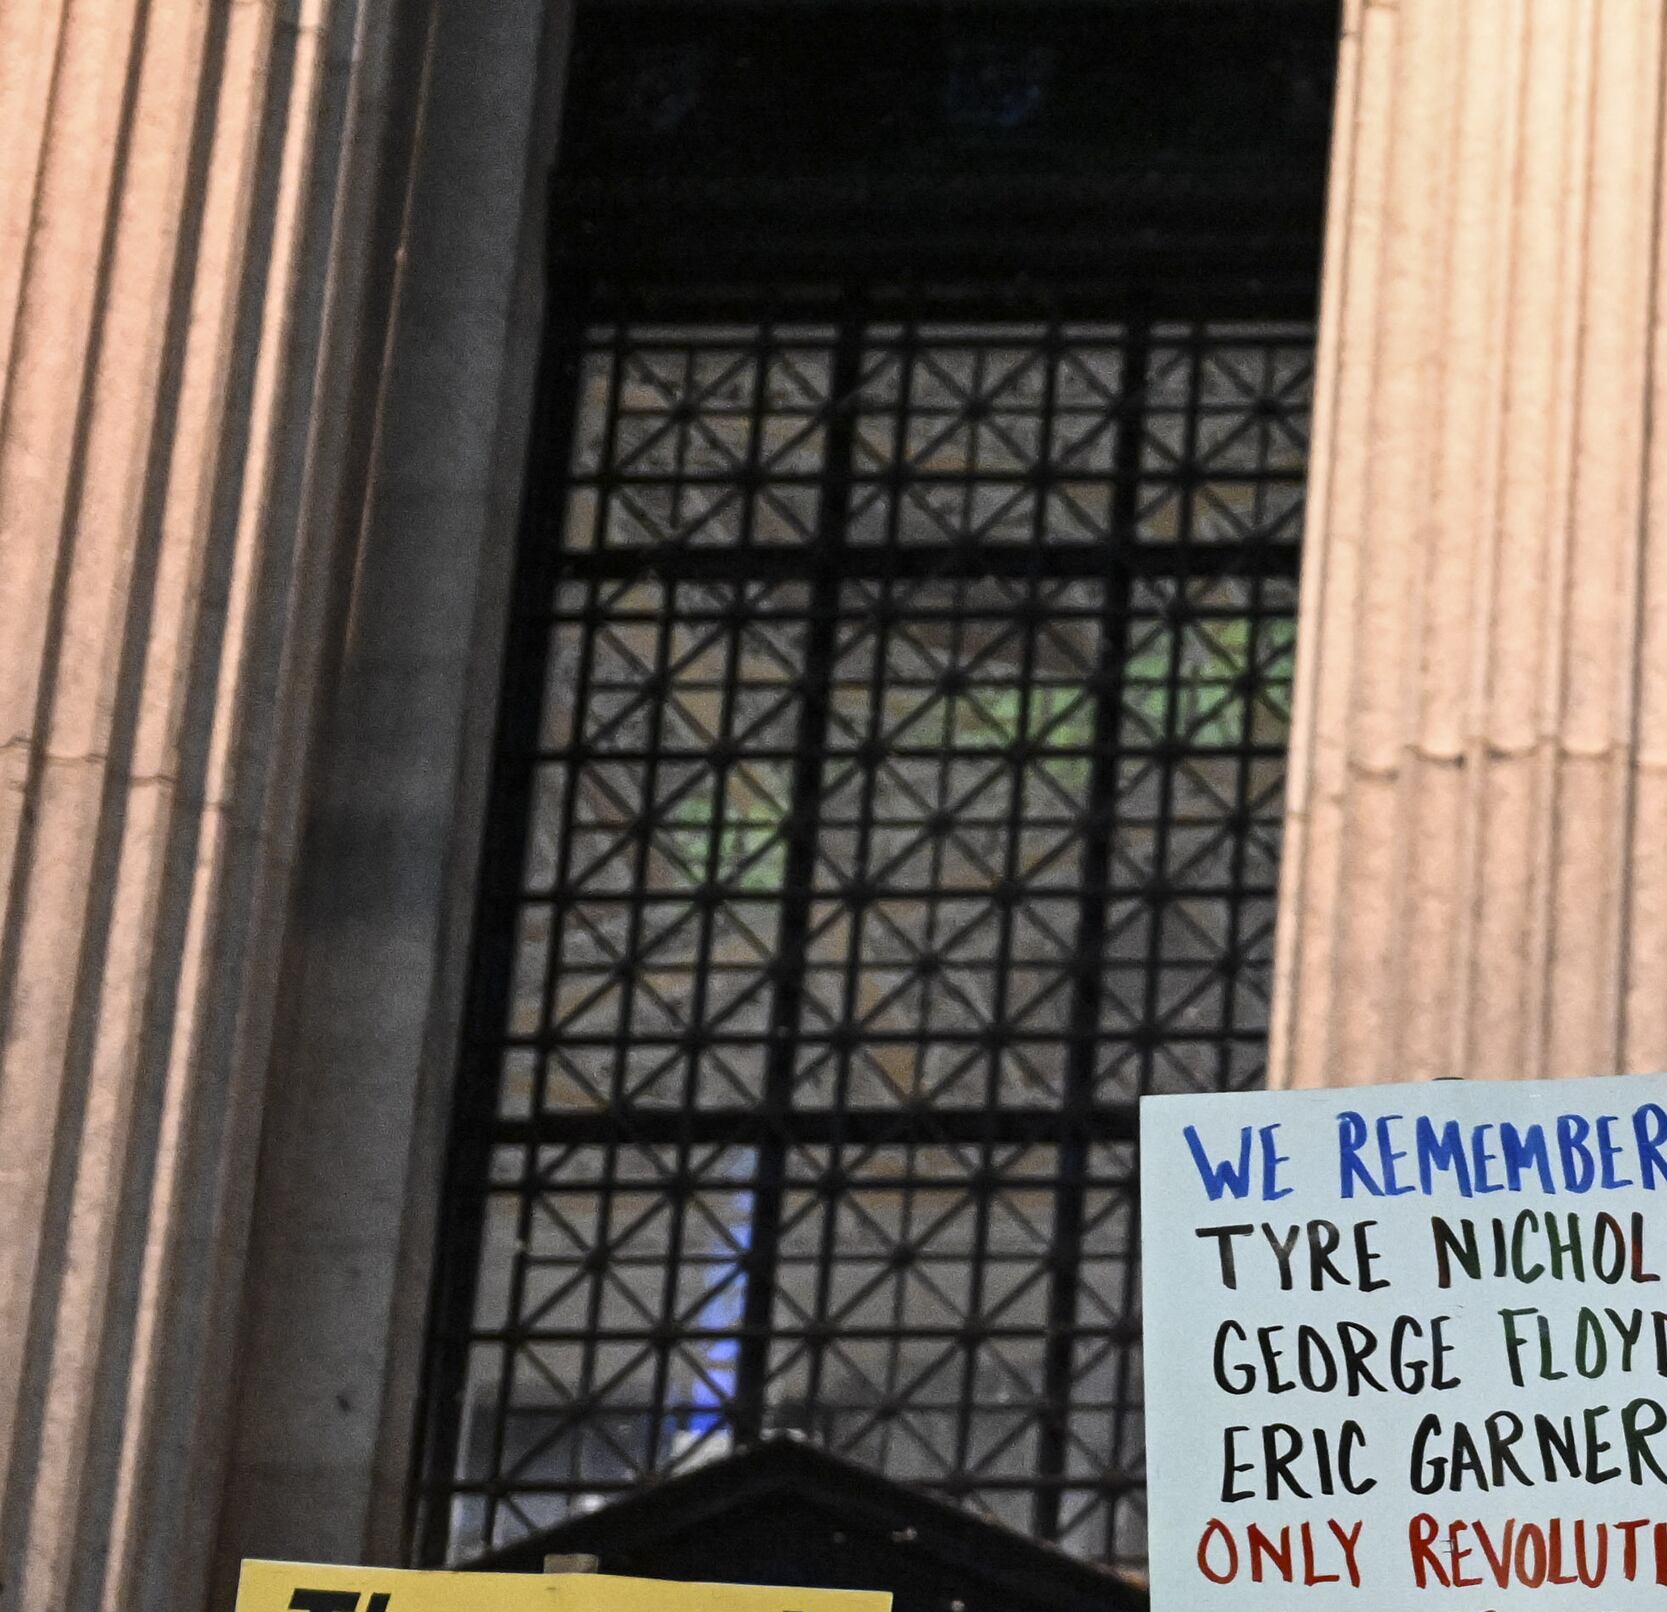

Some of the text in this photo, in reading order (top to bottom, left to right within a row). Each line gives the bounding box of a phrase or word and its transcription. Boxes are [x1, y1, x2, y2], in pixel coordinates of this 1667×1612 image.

[1184, 1123, 1294, 1201] WE
[1195, 1219, 1391, 1292] TYRE
[1213, 1314, 1462, 1396] GEORGE
[1220, 1424, 1377, 1504] ERIC
[1198, 1518, 1364, 1587] ONLY
